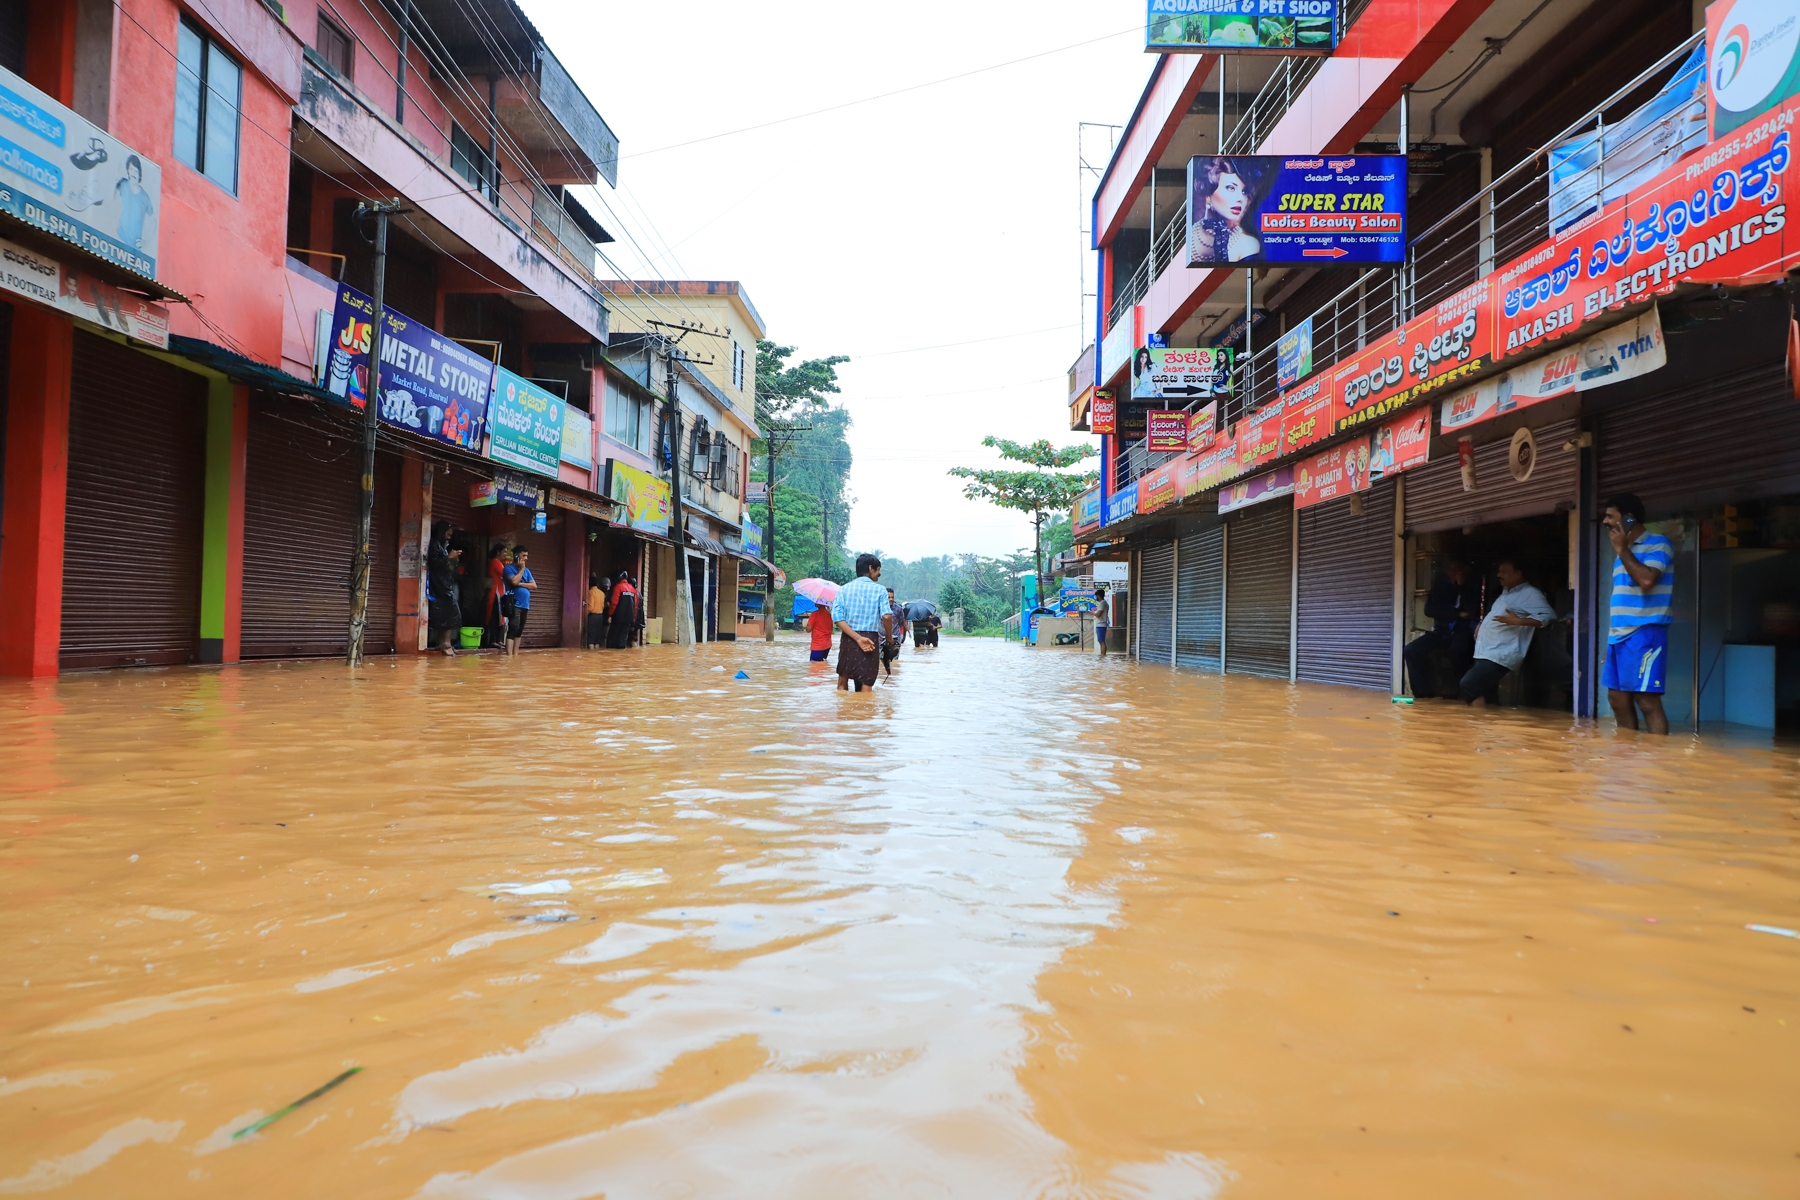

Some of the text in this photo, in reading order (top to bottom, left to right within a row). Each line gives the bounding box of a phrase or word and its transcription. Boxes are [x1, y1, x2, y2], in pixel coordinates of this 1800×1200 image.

[1152, 0, 1332, 15] AQUARIUM & PET SHOP
[1285, 158, 1355, 173] ಸೂಪರ್ ಸ್ಟಾರ್
[1278, 193, 1385, 212] SUPER STAR
[1264, 215, 1397, 231] Ladies Beauty Salon
[25, 202, 151, 275] DILSHA FOOTWEAR
[7, 273, 56, 302] FOOTWEAR
[1504, 247, 1581, 317] ಆಕಾಶ್
[1506, 302, 1574, 352] AKASH
[1584, 204, 1787, 316] ELECTRONICS
[1164, 350, 1211, 366] ತುಳಸಿ
[1617, 334, 1653, 360] TATA
[380, 333, 435, 383] METAL
[440, 362, 487, 405] STORE
[1541, 352, 1580, 384] SUN
[392, 373, 413, 389] Market
[412, 382, 428, 397] Road,
[1344, 355, 1404, 408] ಭಾರತಿ
[1340, 390, 1409, 430] BHARATHI
[1412, 359, 1481, 397] SWEETS
[1451, 391, 1478, 416] SUN
[518, 443, 538, 459] MEDICAL
[540, 452, 557, 466] CENTRE
[1315, 467, 1342, 488] BHARATHI
[1320, 484, 1336, 498] SWEETS
